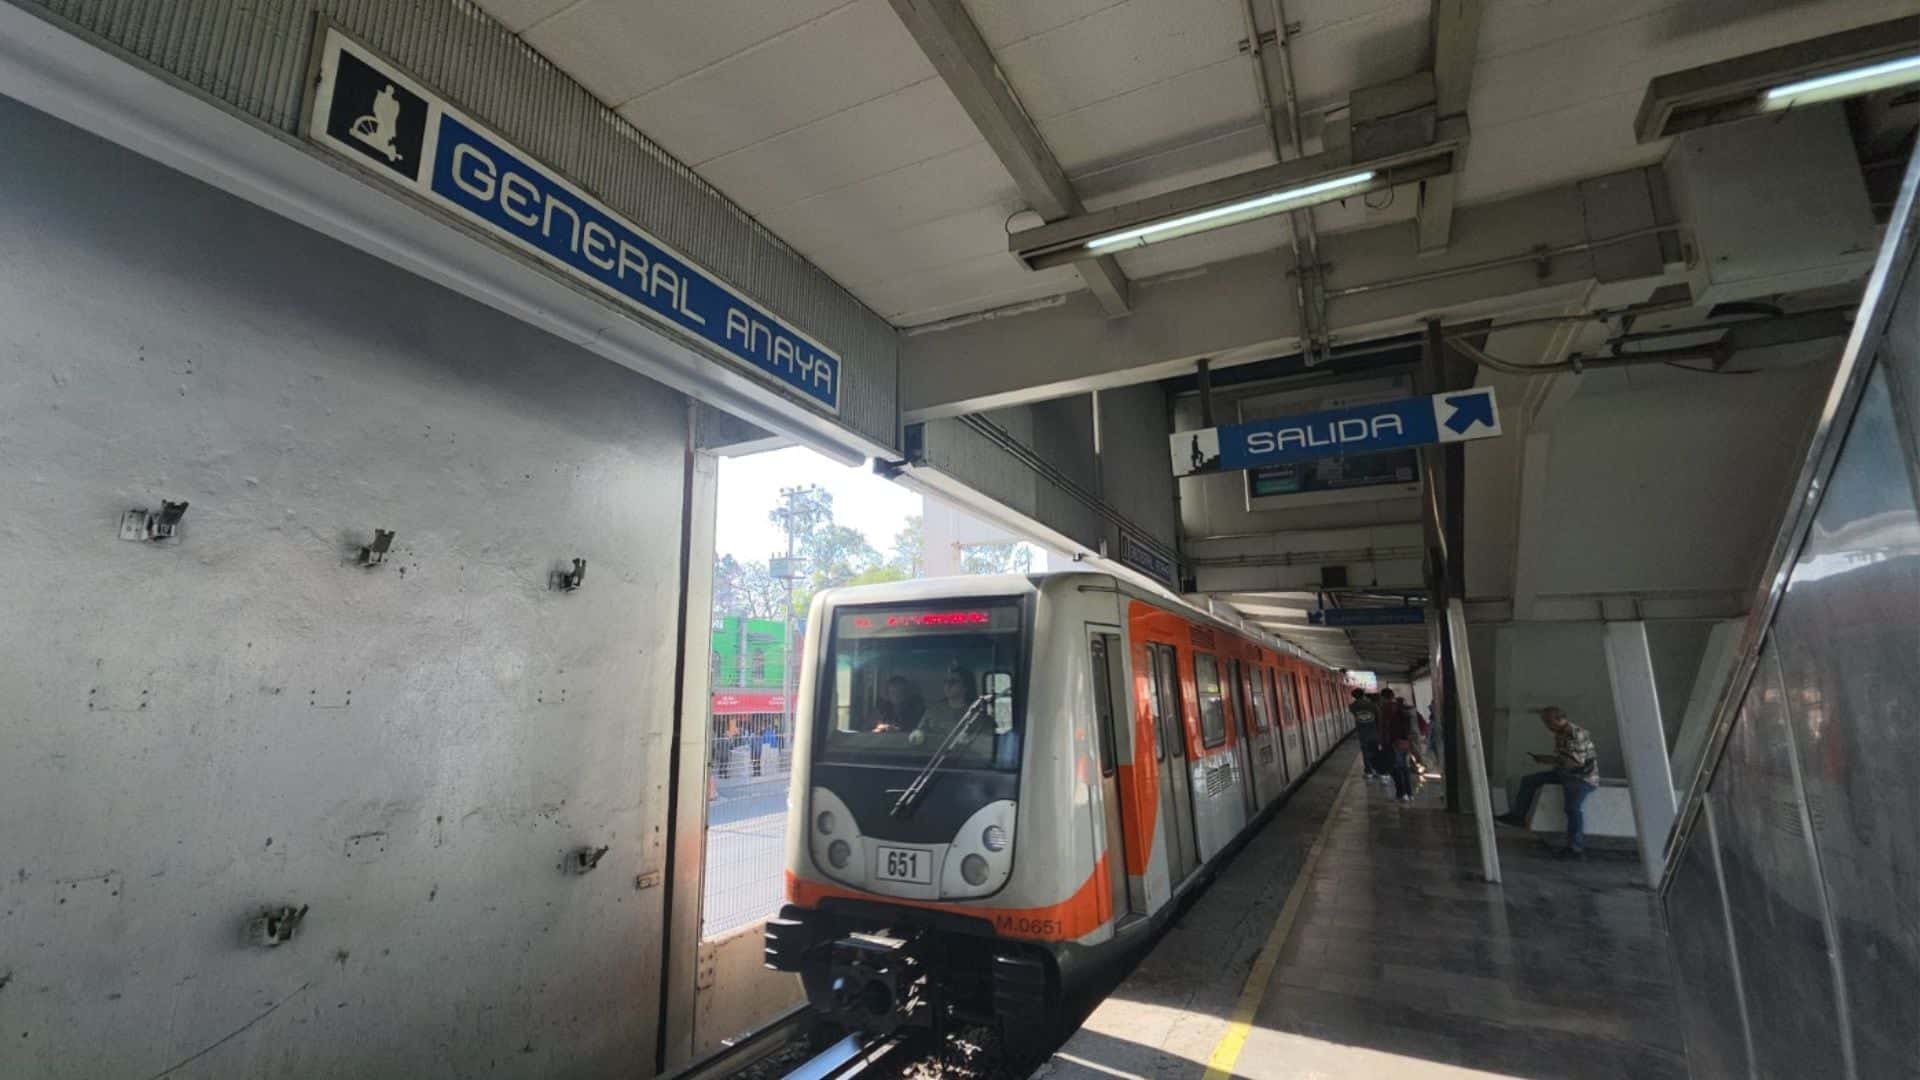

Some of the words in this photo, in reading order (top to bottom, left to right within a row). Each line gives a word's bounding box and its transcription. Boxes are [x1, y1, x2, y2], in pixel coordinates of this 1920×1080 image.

[452, 142, 706, 326] GENERAL
[726, 307, 832, 395] ANAYA
[1247, 413, 1403, 454] SALIDA
[888, 851, 917, 878] 651
[997, 914, 1062, 935] M.0651
